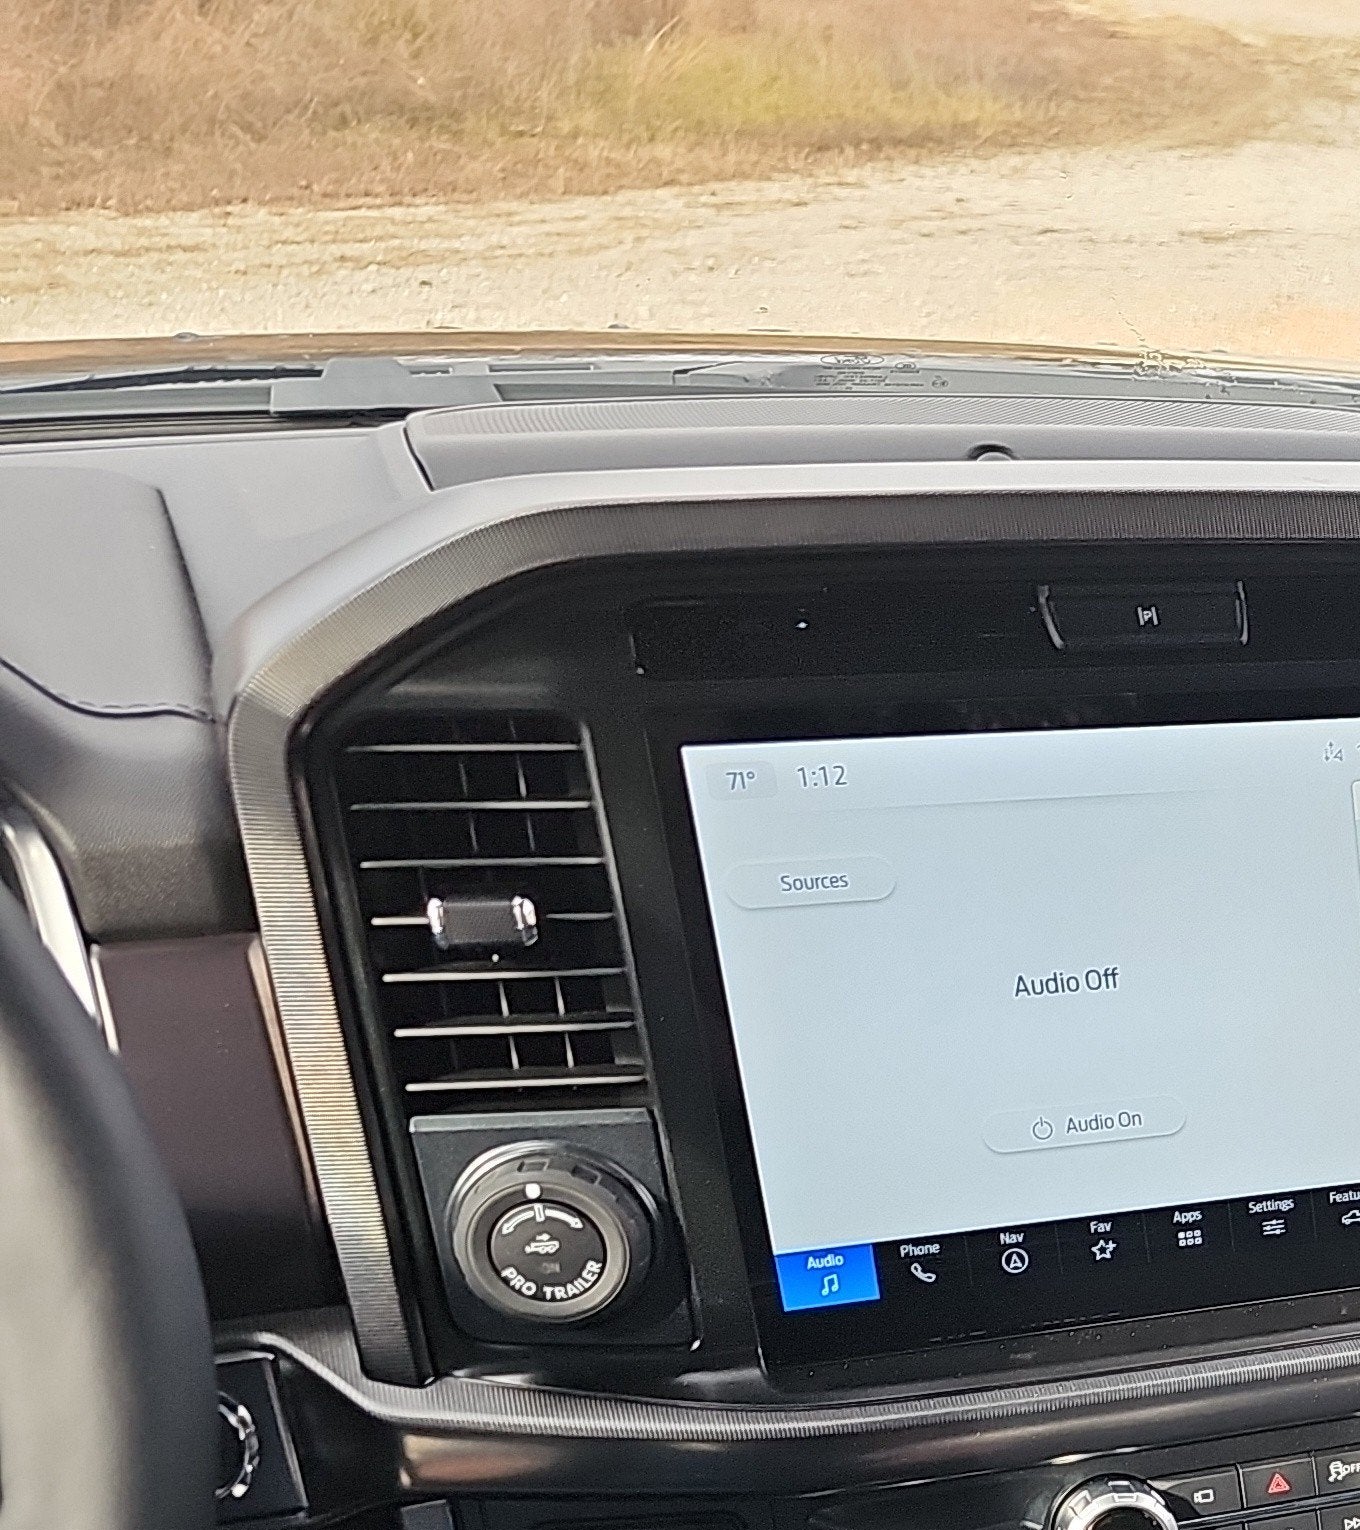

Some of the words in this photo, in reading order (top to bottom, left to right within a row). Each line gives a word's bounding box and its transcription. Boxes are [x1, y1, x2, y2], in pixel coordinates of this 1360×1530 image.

[725, 770, 756, 791] 71°
[797, 764, 848, 788] 1:12
[780, 873, 849, 893] Sources
[1014, 971, 1080, 997] Audio
[1085, 966, 1119, 991] Off
[1066, 1114, 1115, 1134] Audio
[1118, 1111, 1142, 1128] On
[1248, 1197, 1295, 1215] Settings
[1173, 1210, 1203, 1224] Apps
[1090, 1220, 1112, 1234] Fav
[999, 1232, 1025, 1245] Nav
[900, 1241, 941, 1258] Phone
[807, 1253, 844, 1270] Audio
[501, 1266, 537, 1296] PRO
[543, 1259, 603, 1300] TRAILER
